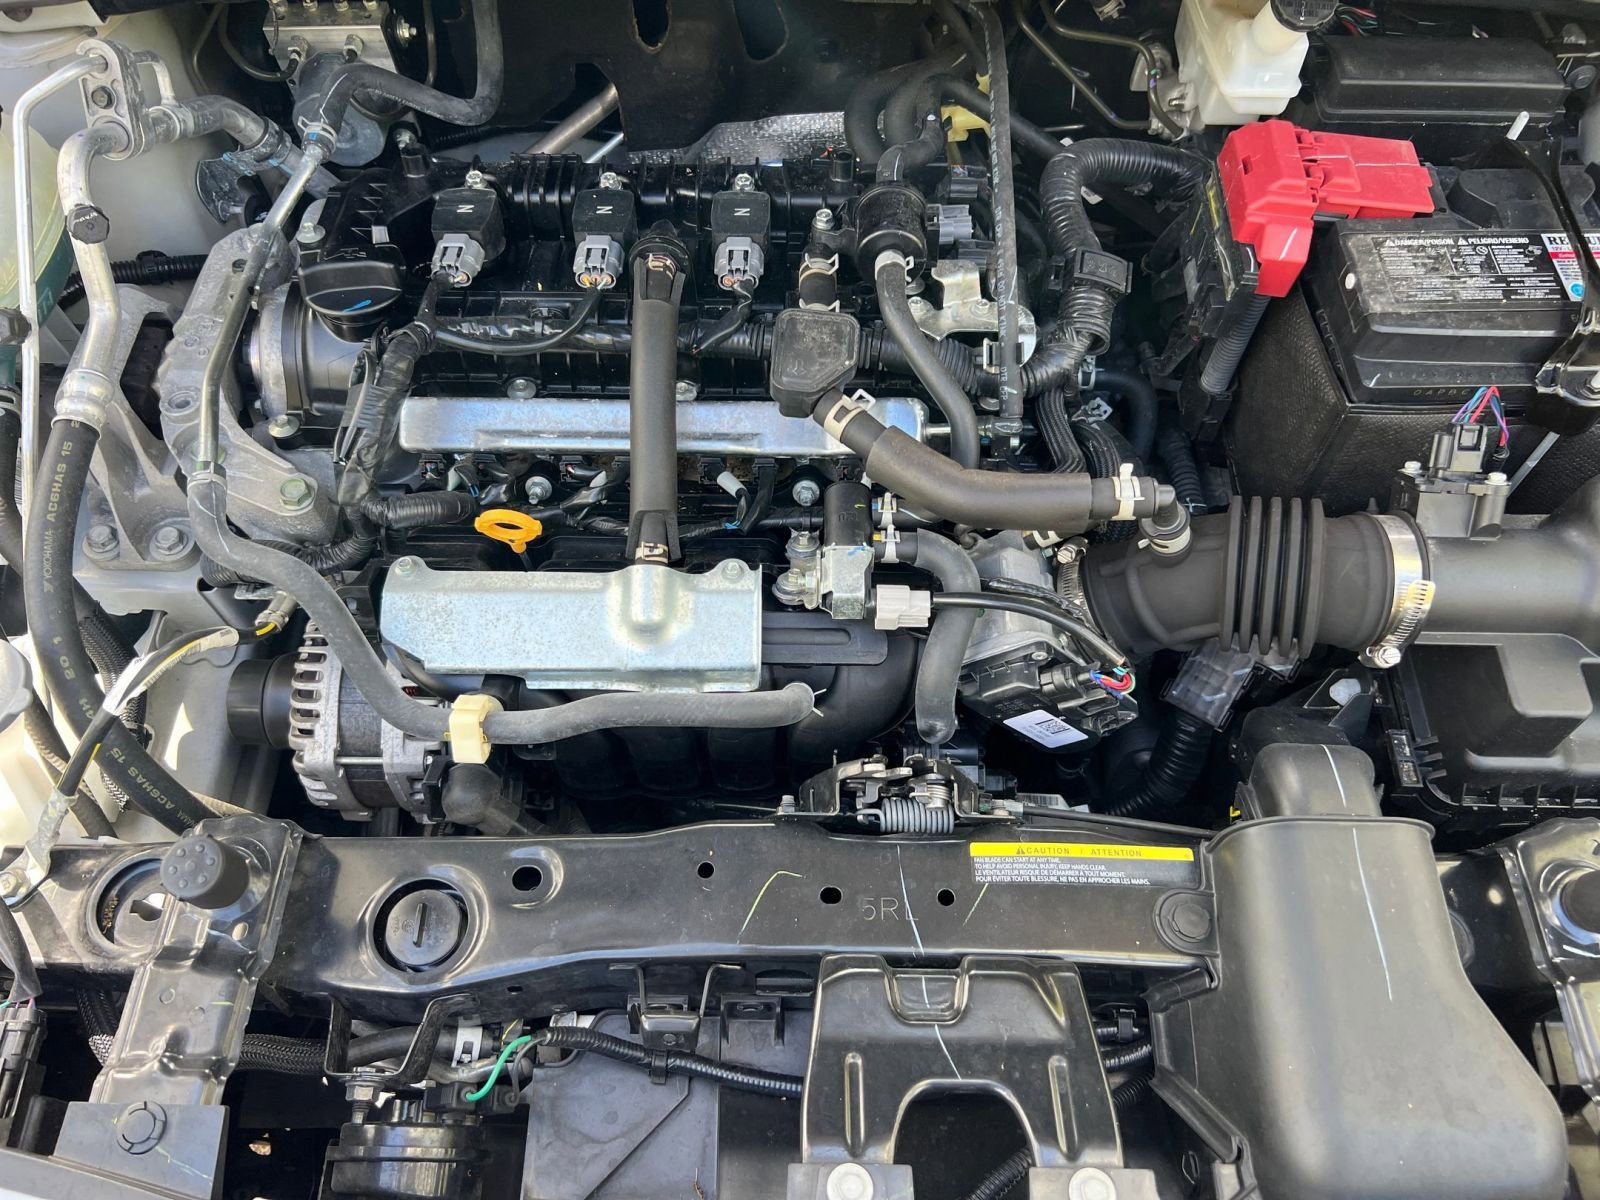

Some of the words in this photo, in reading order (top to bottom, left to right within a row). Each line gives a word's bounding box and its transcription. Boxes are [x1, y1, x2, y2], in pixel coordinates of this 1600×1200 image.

[998, 295, 1006, 311] NOT
[999, 315, 1007, 337] KINK
[61, 440, 73, 457] 15
[46, 463, 67, 522] AC6HAS
[42, 530, 54, 578] YOKOHAMA
[60, 656, 76, 680] 20
[110, 747, 126, 764] 15
[1091, 848, 1142, 856] ATTENTION
[862, 897, 919, 920] 5RL
